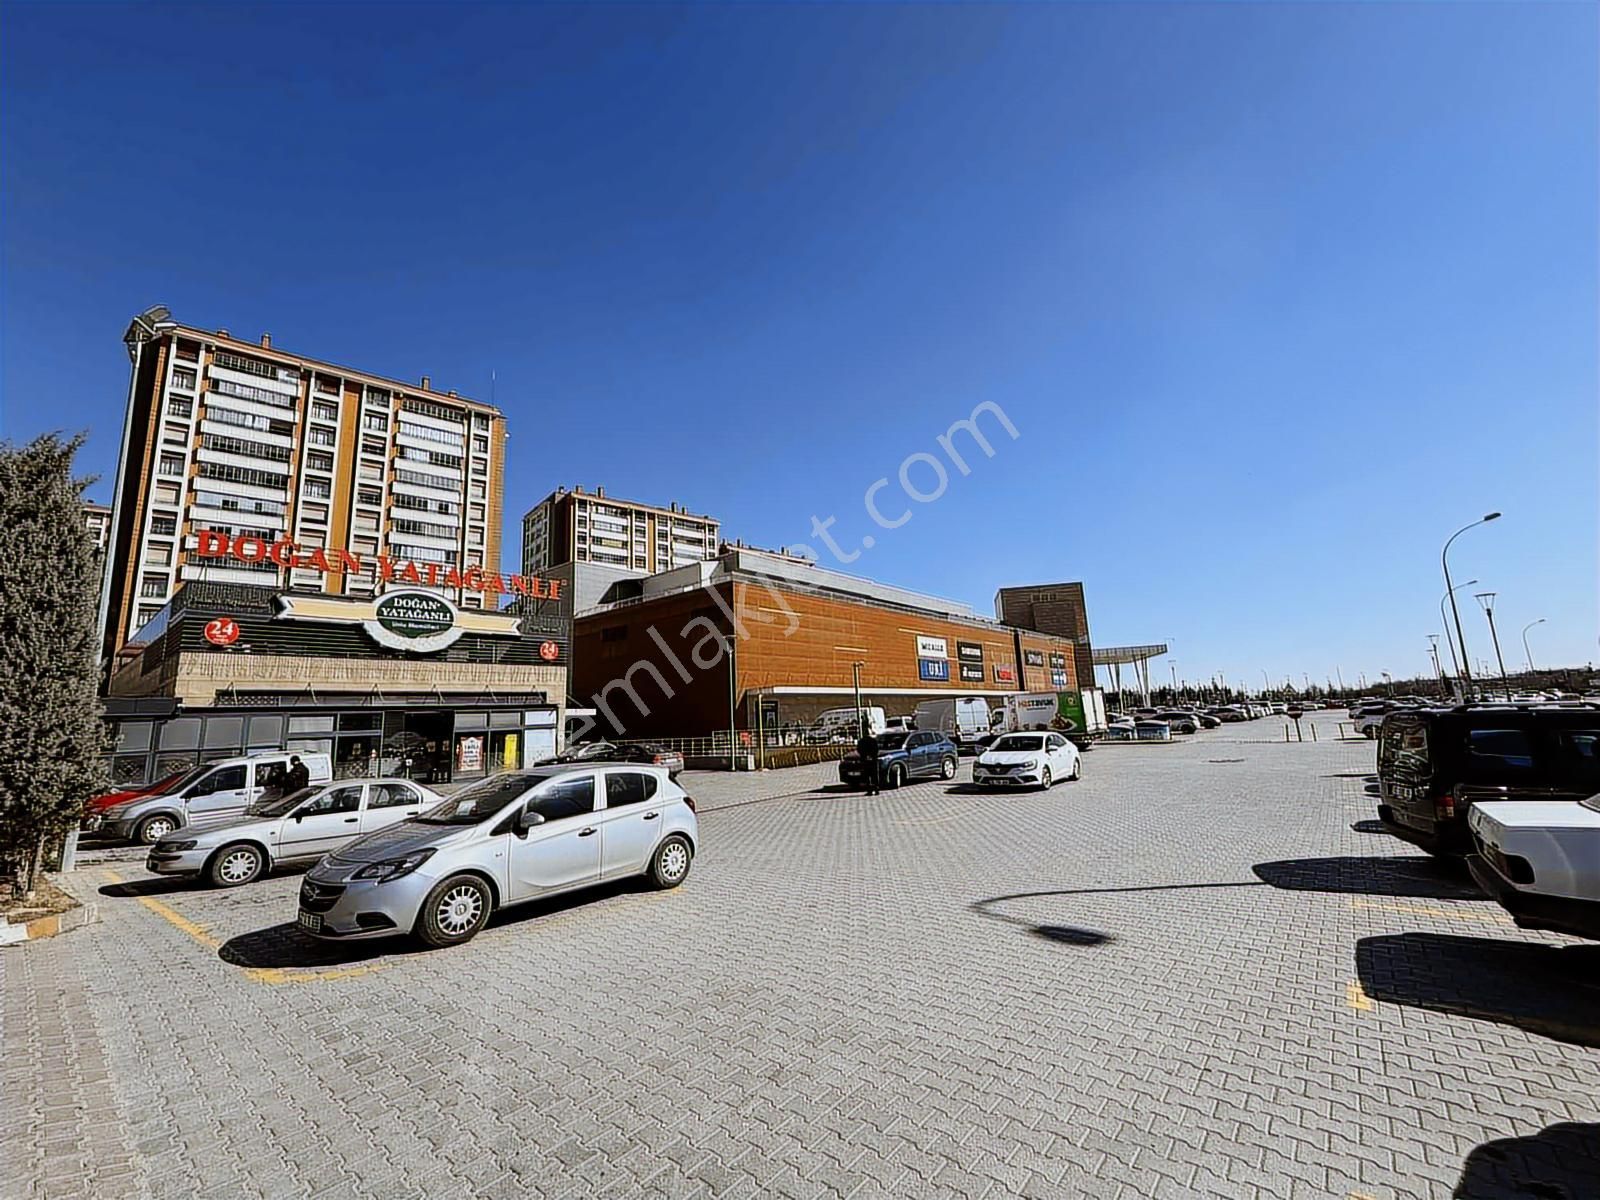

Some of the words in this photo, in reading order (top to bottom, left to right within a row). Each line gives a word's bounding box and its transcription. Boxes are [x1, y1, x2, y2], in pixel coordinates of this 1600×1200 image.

[196, 529, 362, 575] DOĞAN
[377, 554, 562, 600] YATAĞANLI
[393, 597, 438, 610] DOĞAN
[380, 606, 451, 621] YATAĞANLI
[208, 620, 234, 636] 24
